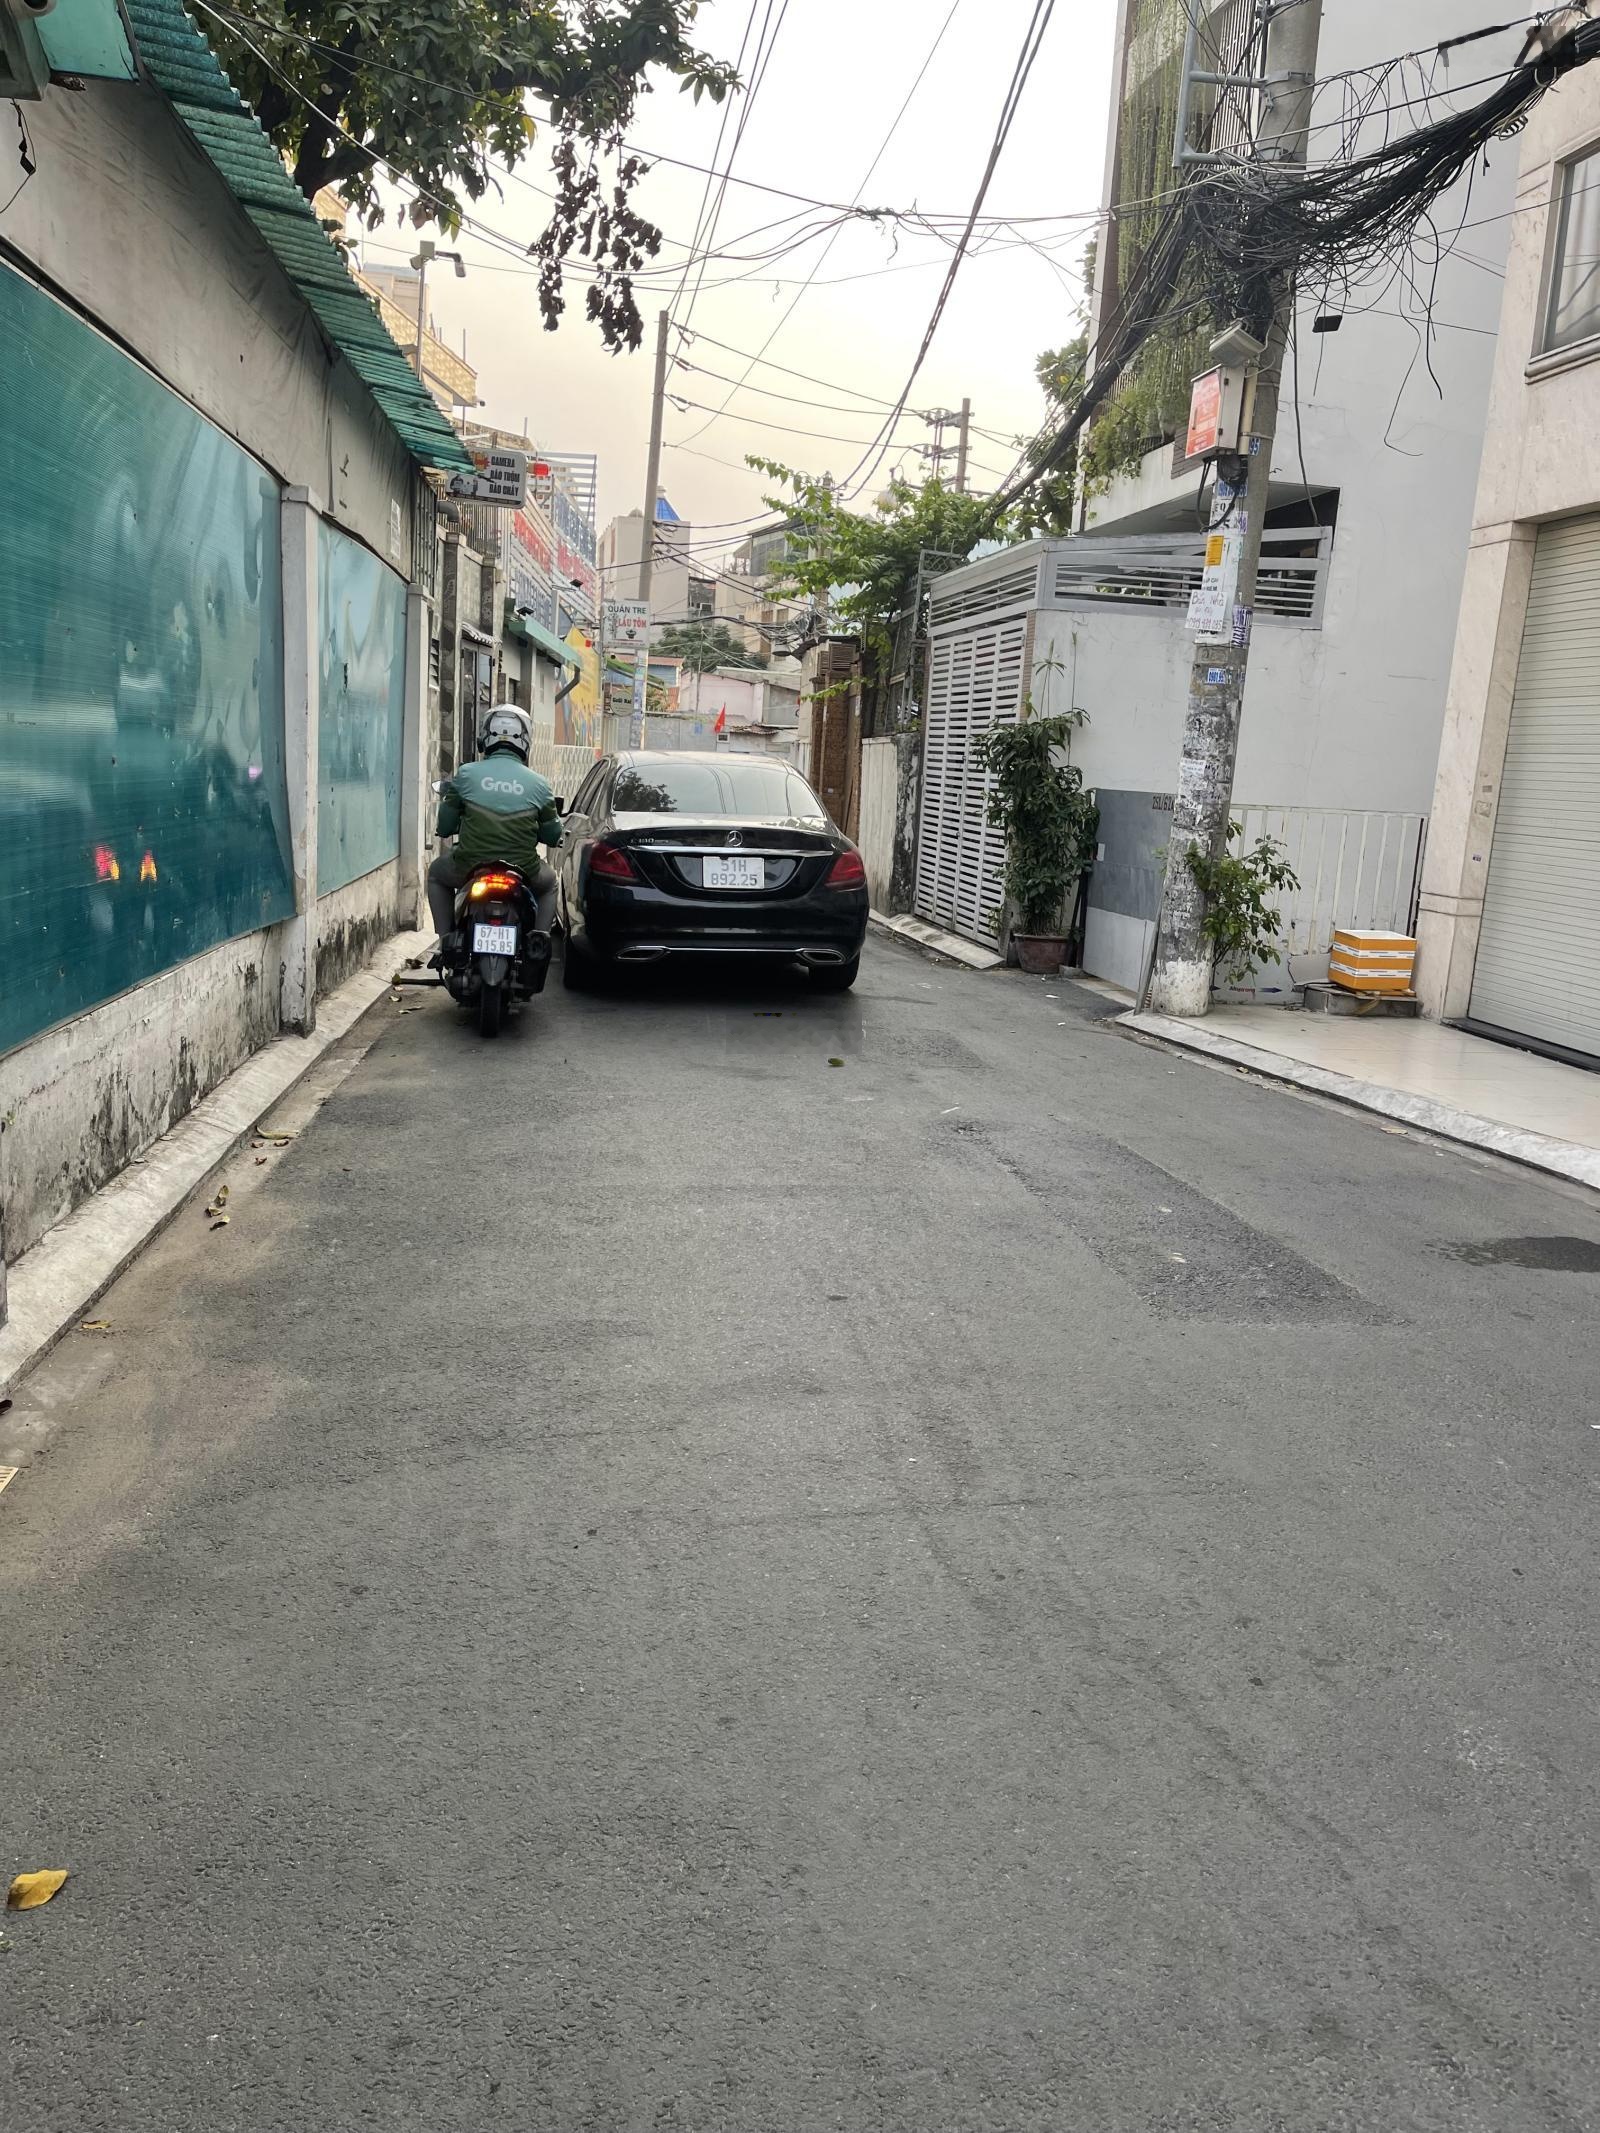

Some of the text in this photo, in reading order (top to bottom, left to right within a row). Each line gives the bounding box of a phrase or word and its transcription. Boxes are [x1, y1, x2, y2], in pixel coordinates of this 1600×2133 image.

[491, 456, 515, 468] CAMERA
[632, 606, 647, 614] TRE
[481, 776, 524, 795] Grab
[720, 859, 747, 873] 51H
[710, 873, 758, 887] 892.25
[480, 926, 510, 941] 67-H1
[476, 939, 513, 953] 915.85
